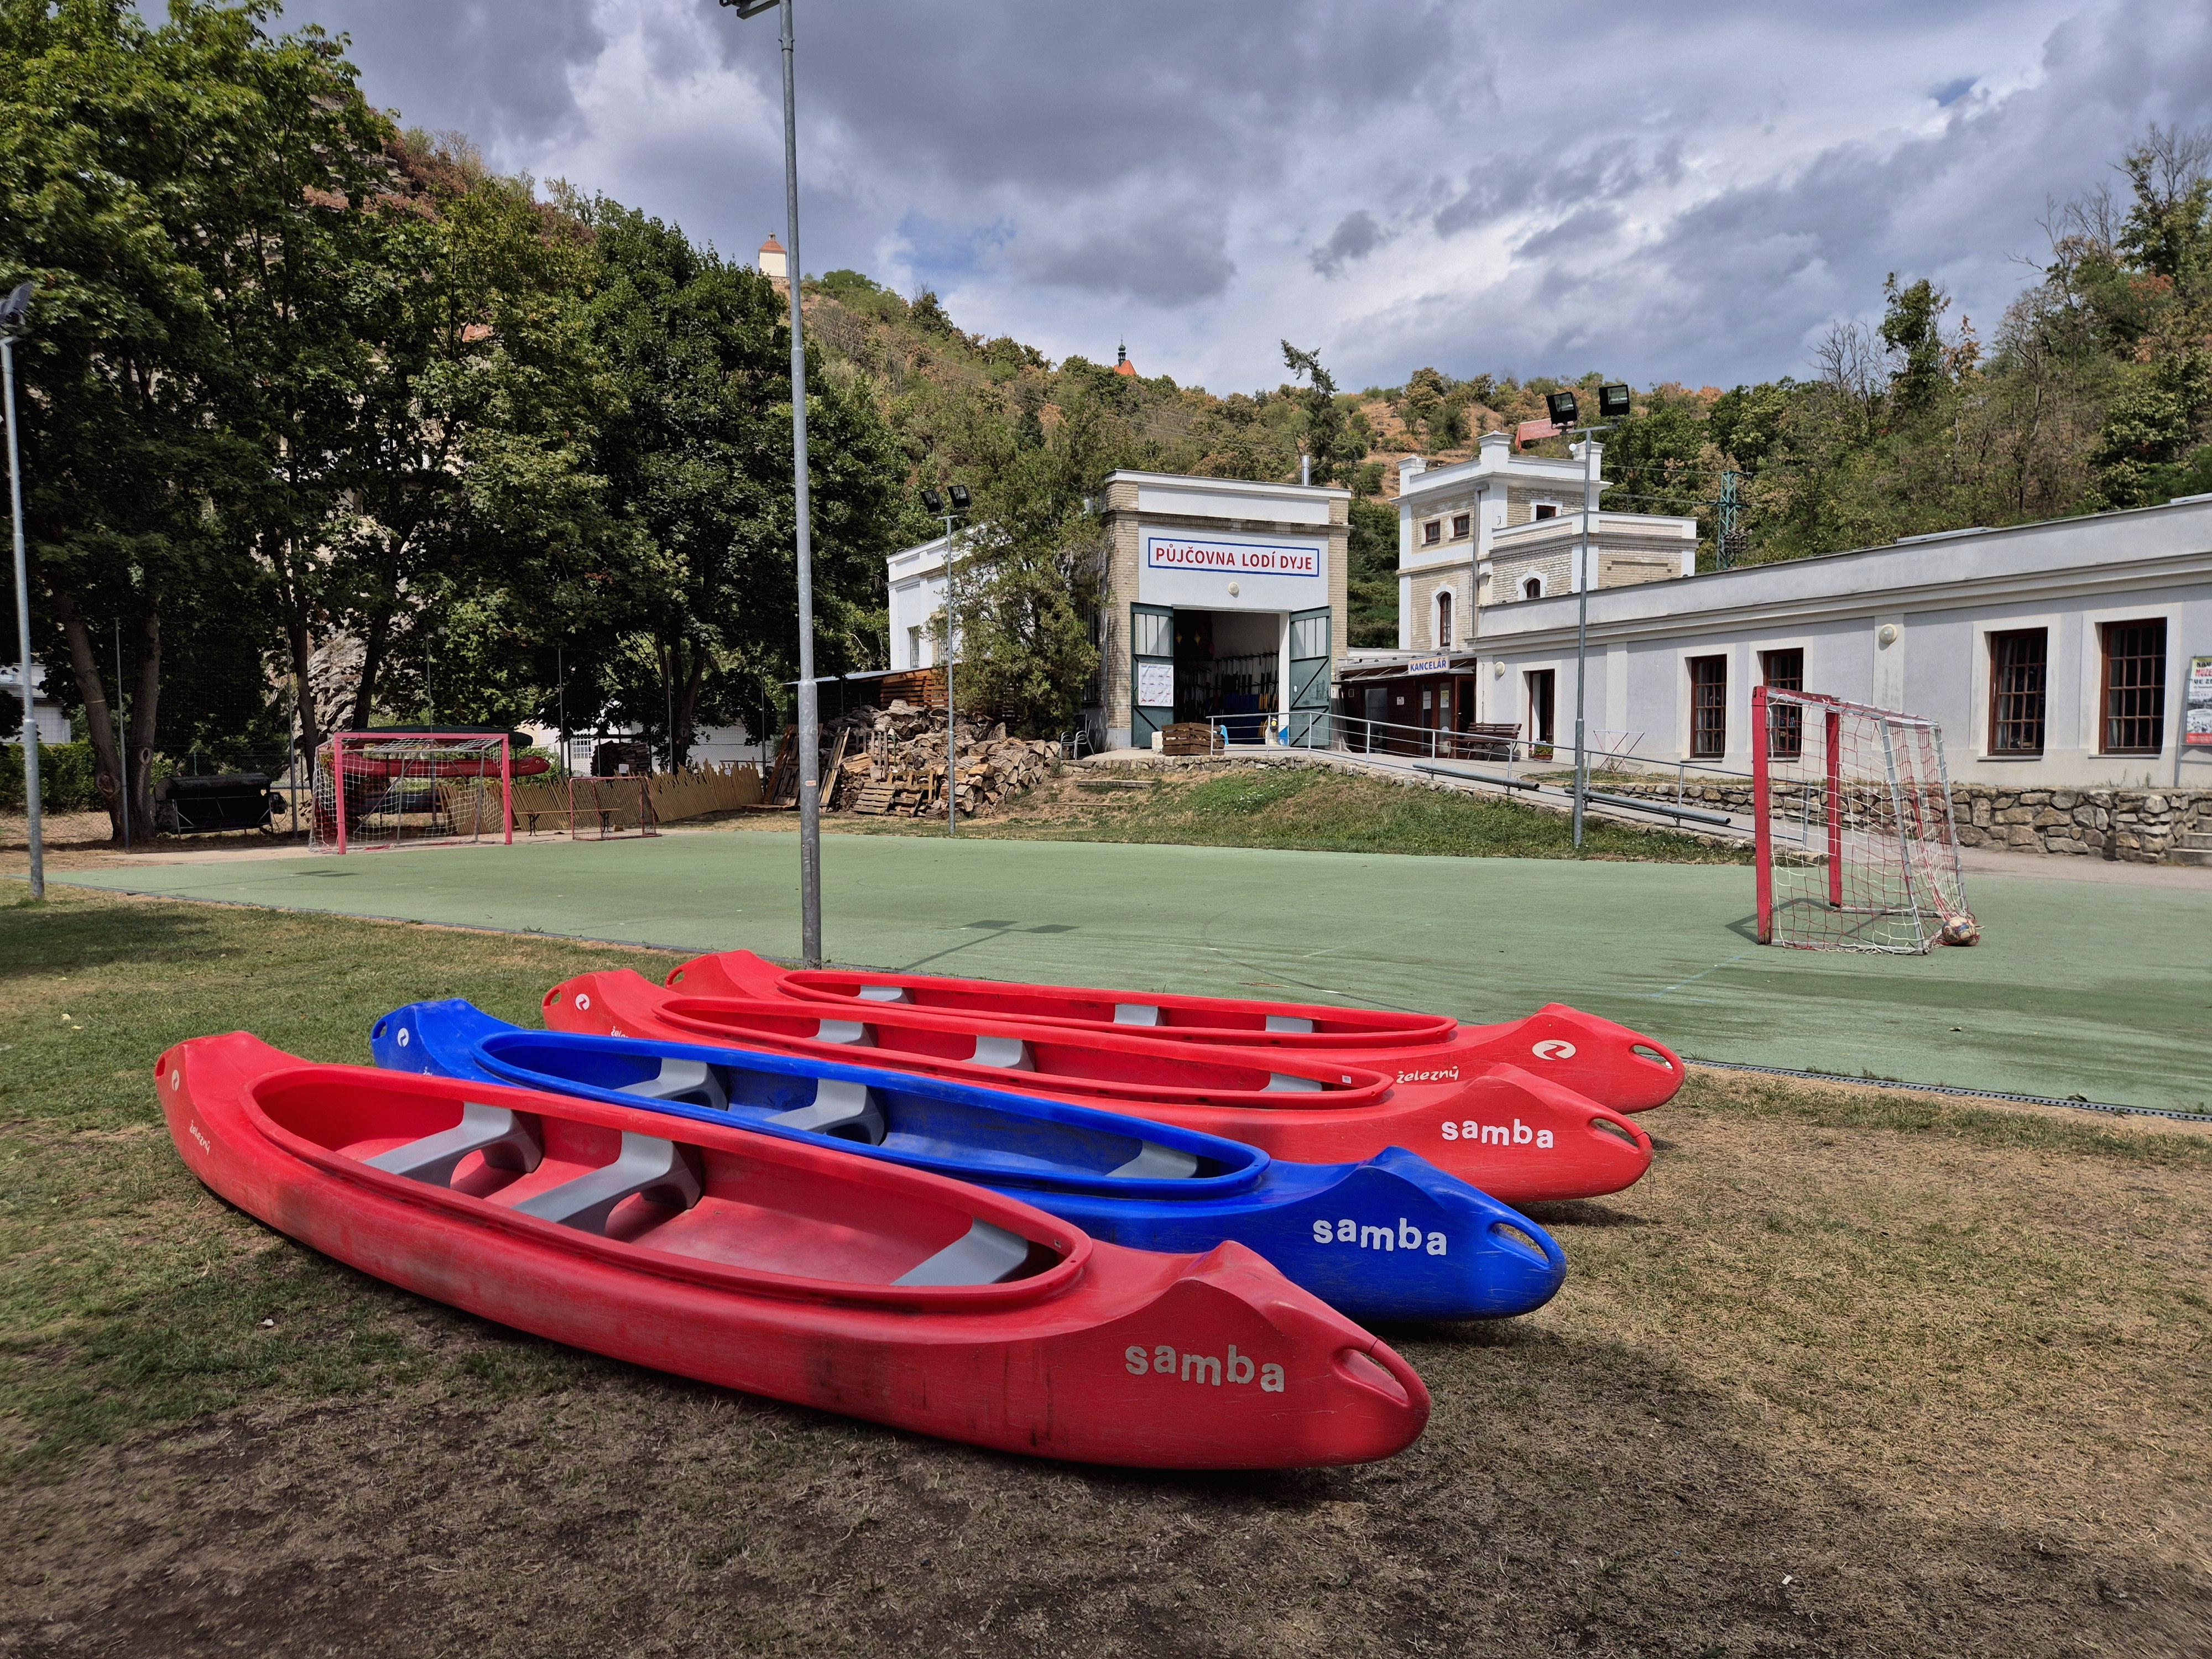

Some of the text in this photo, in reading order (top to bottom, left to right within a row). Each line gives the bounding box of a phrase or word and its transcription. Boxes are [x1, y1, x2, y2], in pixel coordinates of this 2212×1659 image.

[1156, 544, 1312, 570] PŮJČOVNA LODÍ DYJE
[1410, 658, 1447, 672] KANCELÁŘ
[1396, 1066, 1459, 1084] železný
[1441, 1118, 1553, 1149] samba
[1313, 1217, 1447, 1256] samba
[1125, 1344, 1285, 1392] samba
